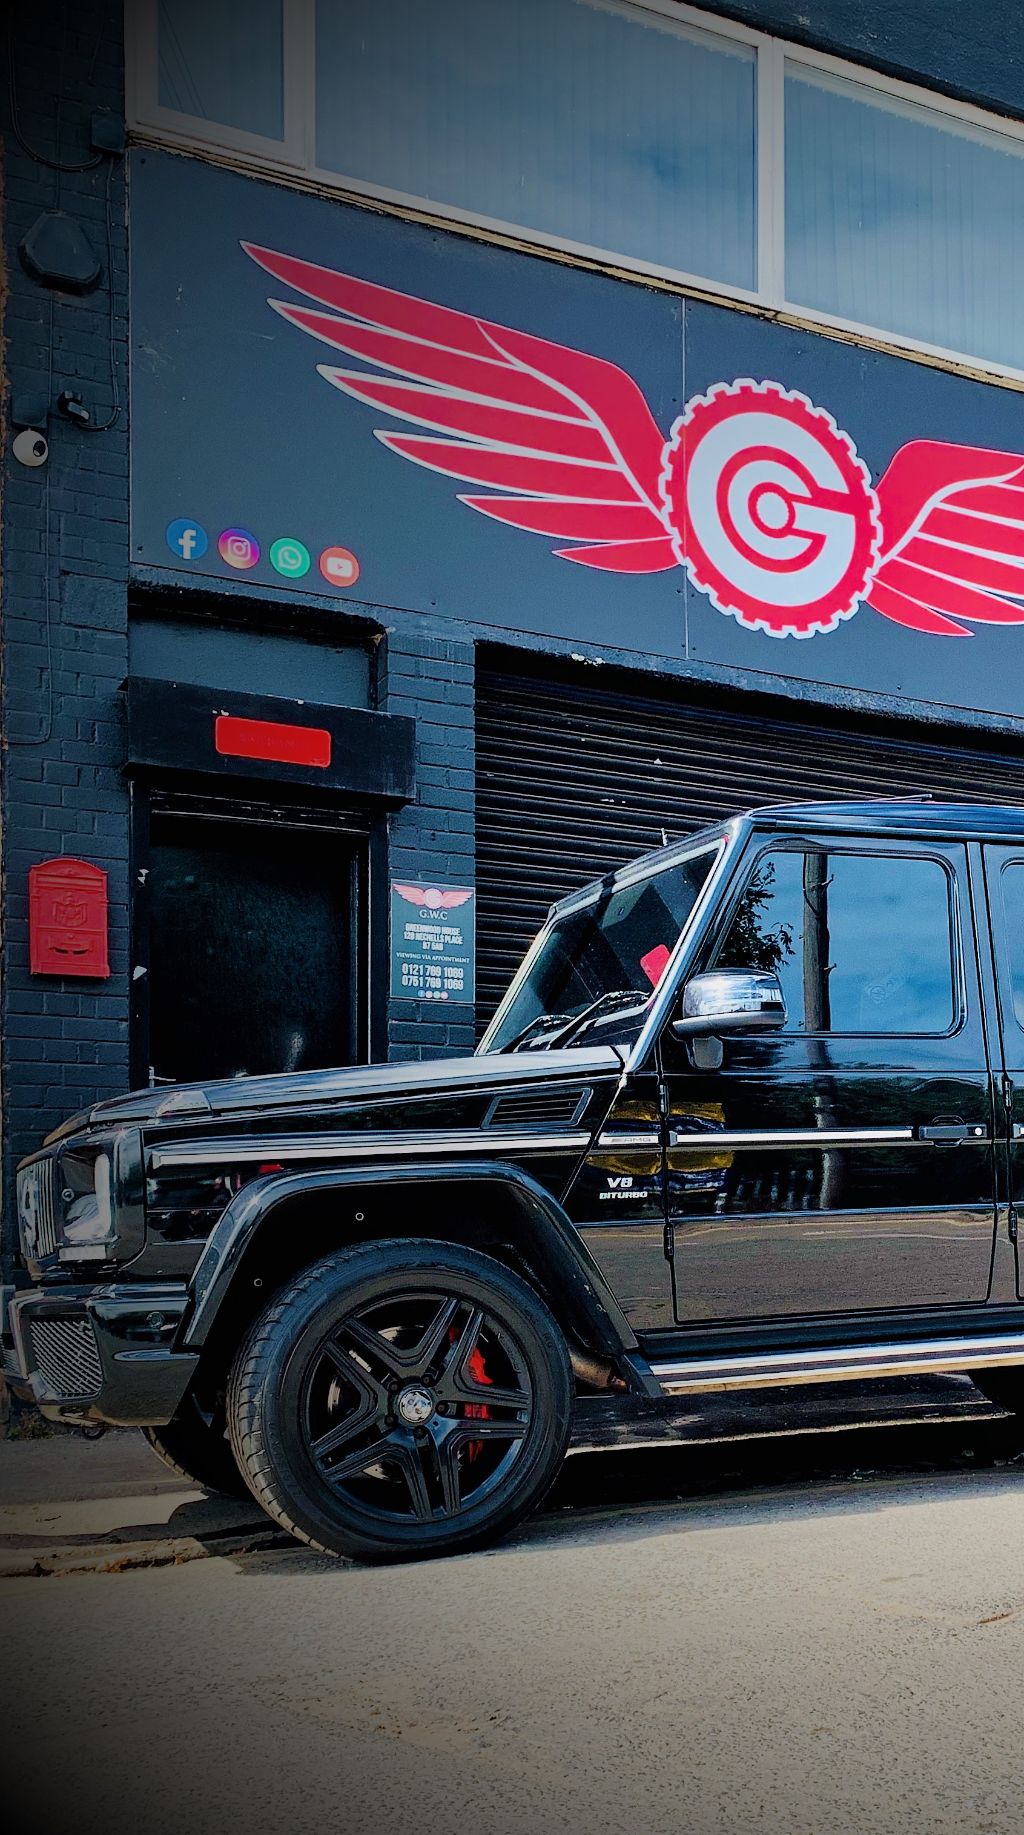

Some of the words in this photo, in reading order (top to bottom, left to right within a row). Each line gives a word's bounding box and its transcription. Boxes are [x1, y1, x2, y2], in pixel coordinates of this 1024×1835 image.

[444, 935, 463, 945] PLACE
[396, 952, 421, 960] VIEWING
[402, 963, 423, 976] 0121
[425, 965, 441, 977] 769
[443, 966, 464, 979] 1069
[402, 975, 423, 987] 0751
[425, 977, 441, 989] 769
[443, 978, 464, 990] 1069
[607, 1177, 633, 1188] V8
[599, 1191, 648, 1200] BITURBO
